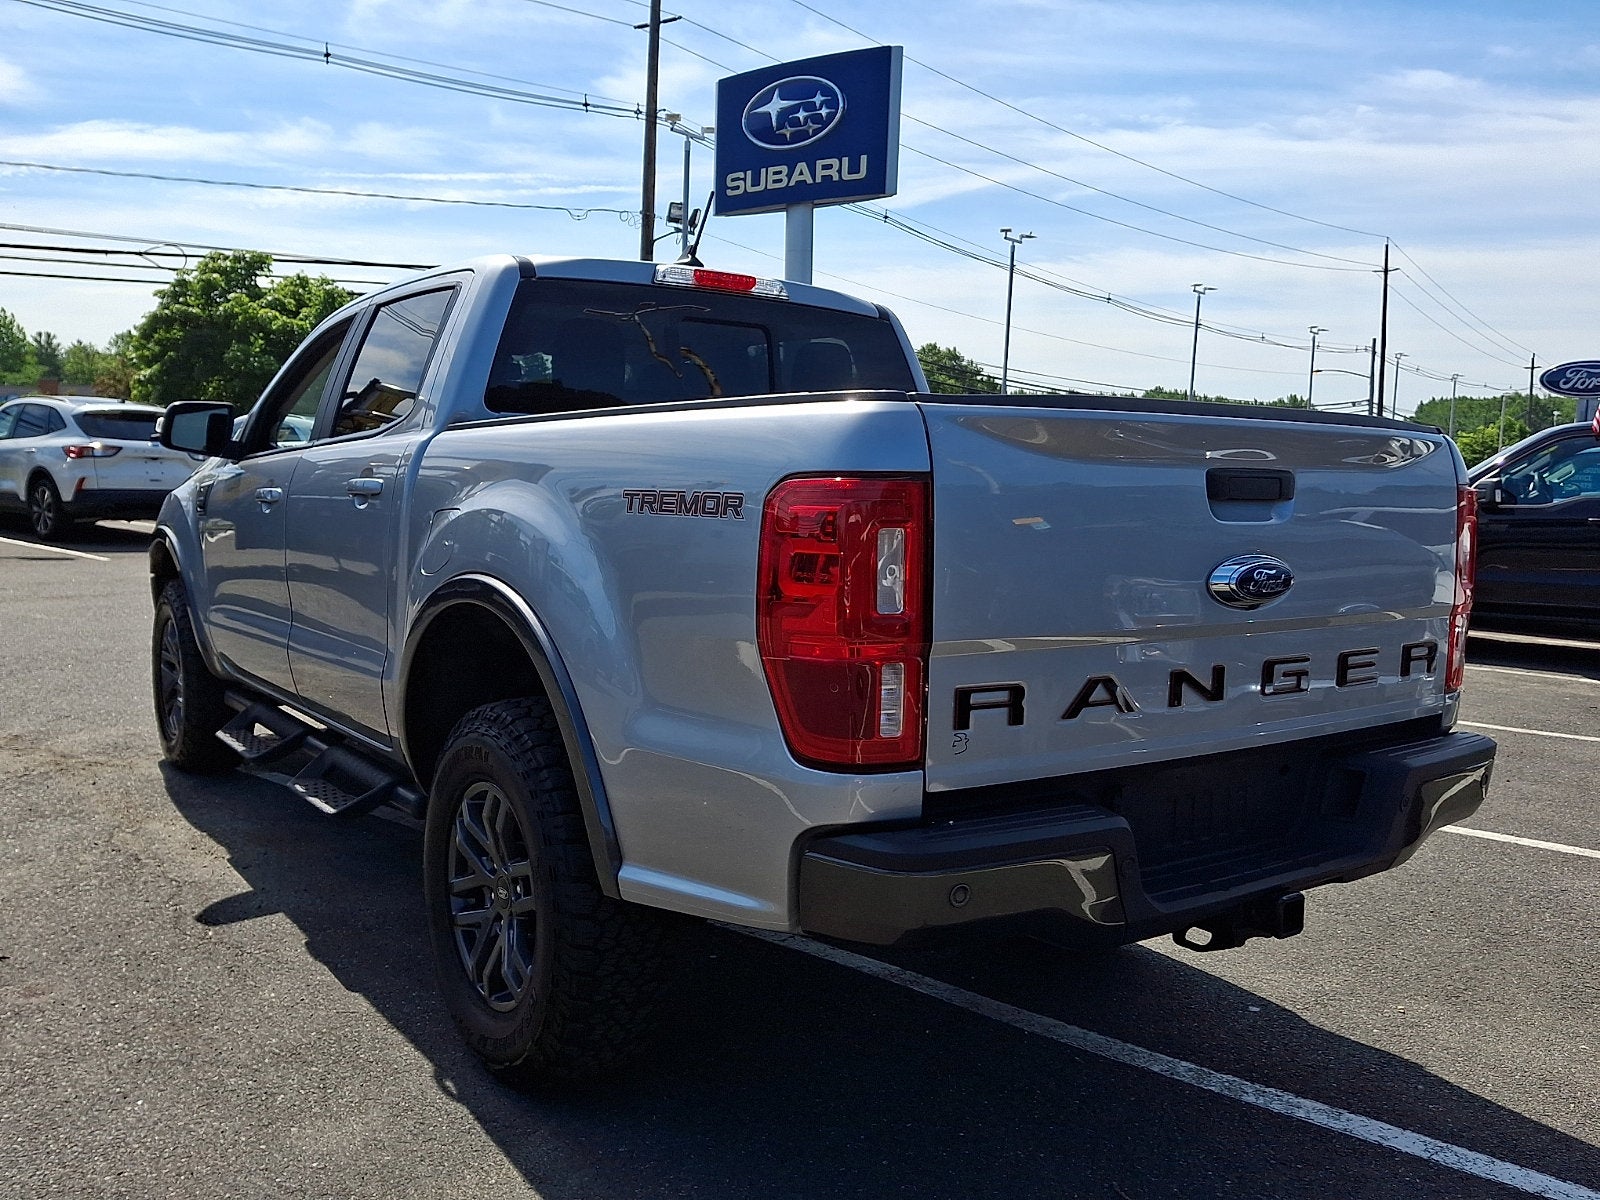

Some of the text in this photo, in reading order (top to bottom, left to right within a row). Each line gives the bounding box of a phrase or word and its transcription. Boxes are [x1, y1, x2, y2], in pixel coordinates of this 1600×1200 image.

[726, 154, 868, 196] SUBARU
[622, 489, 745, 520] TREMOR
[953, 641, 1438, 731] RANGER
